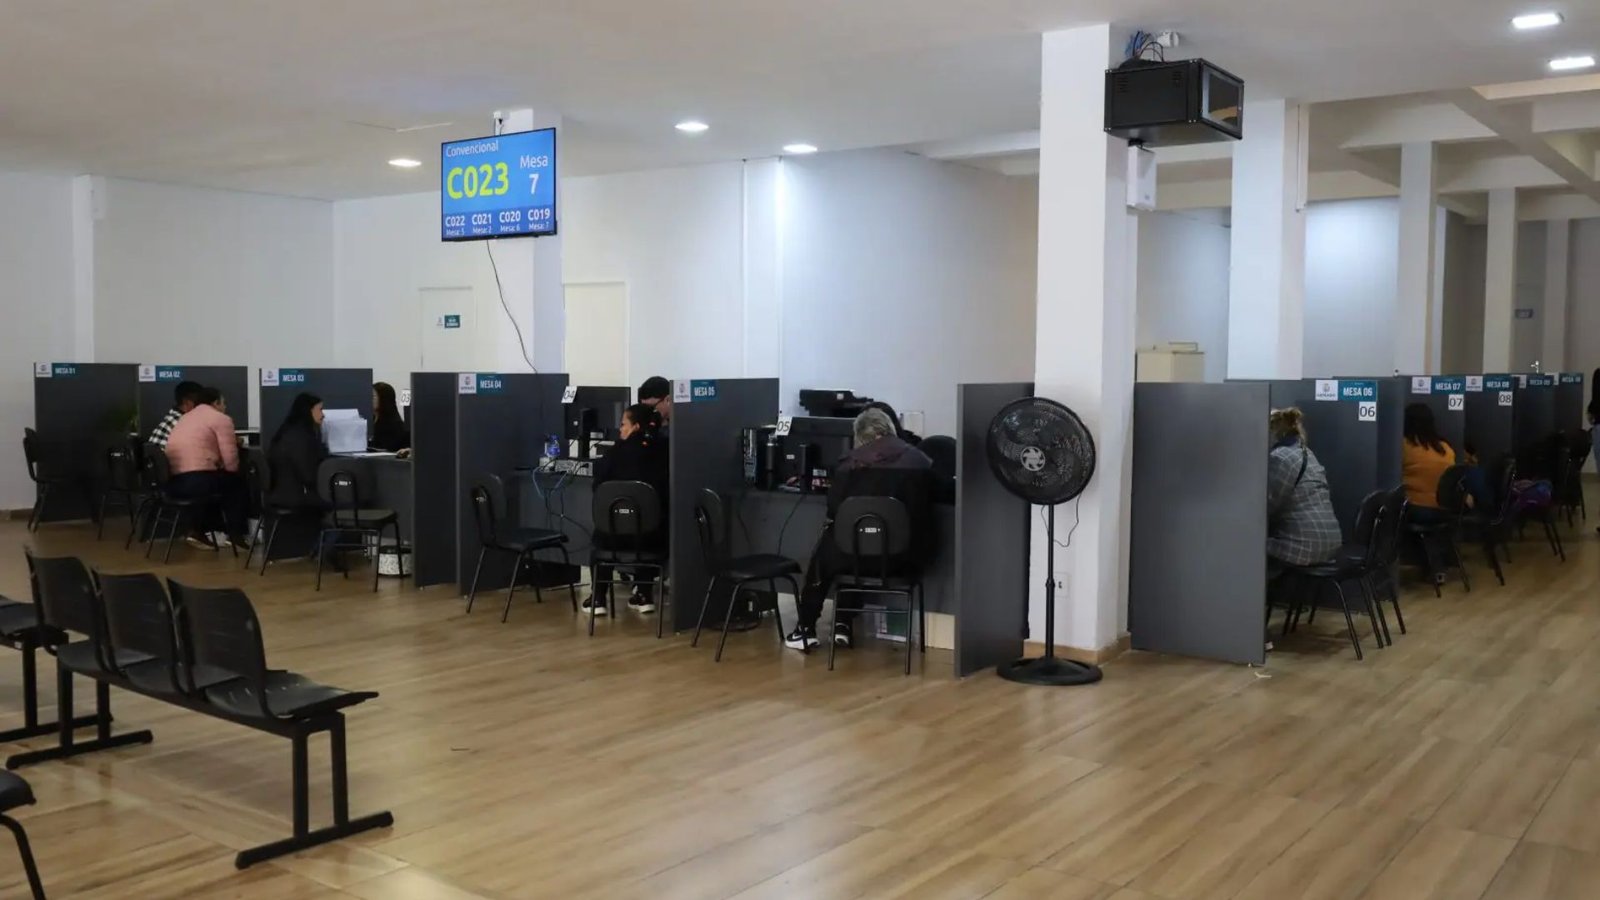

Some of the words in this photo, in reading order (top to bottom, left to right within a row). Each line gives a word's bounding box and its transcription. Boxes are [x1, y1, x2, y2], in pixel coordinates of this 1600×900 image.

[446, 140, 499, 157] Convencional
[520, 155, 548, 168] Mesa
[447, 162, 509, 199] C023
[529, 173, 539, 194] 7
[445, 215, 465, 227] C022
[471, 213, 492, 225] C021
[499, 211, 521, 223] C020
[527, 208, 550, 221] C019
[282, 374, 297, 382] MESA
[297, 374, 304, 382] 03
[480, 380, 494, 389] MESA
[494, 380, 502, 389] 04
[1435, 382, 1452, 390] MESA
[563, 390, 575, 400] 04
[694, 387, 708, 397] MESA
[708, 386, 716, 396] 05
[1343, 387, 1362, 396] MESA
[1363, 387, 1373, 396] 06
[1449, 398, 1462, 407] 07
[1500, 394, 1511, 403] 08
[1360, 406, 1376, 418] 06
[776, 421, 790, 432] 05
